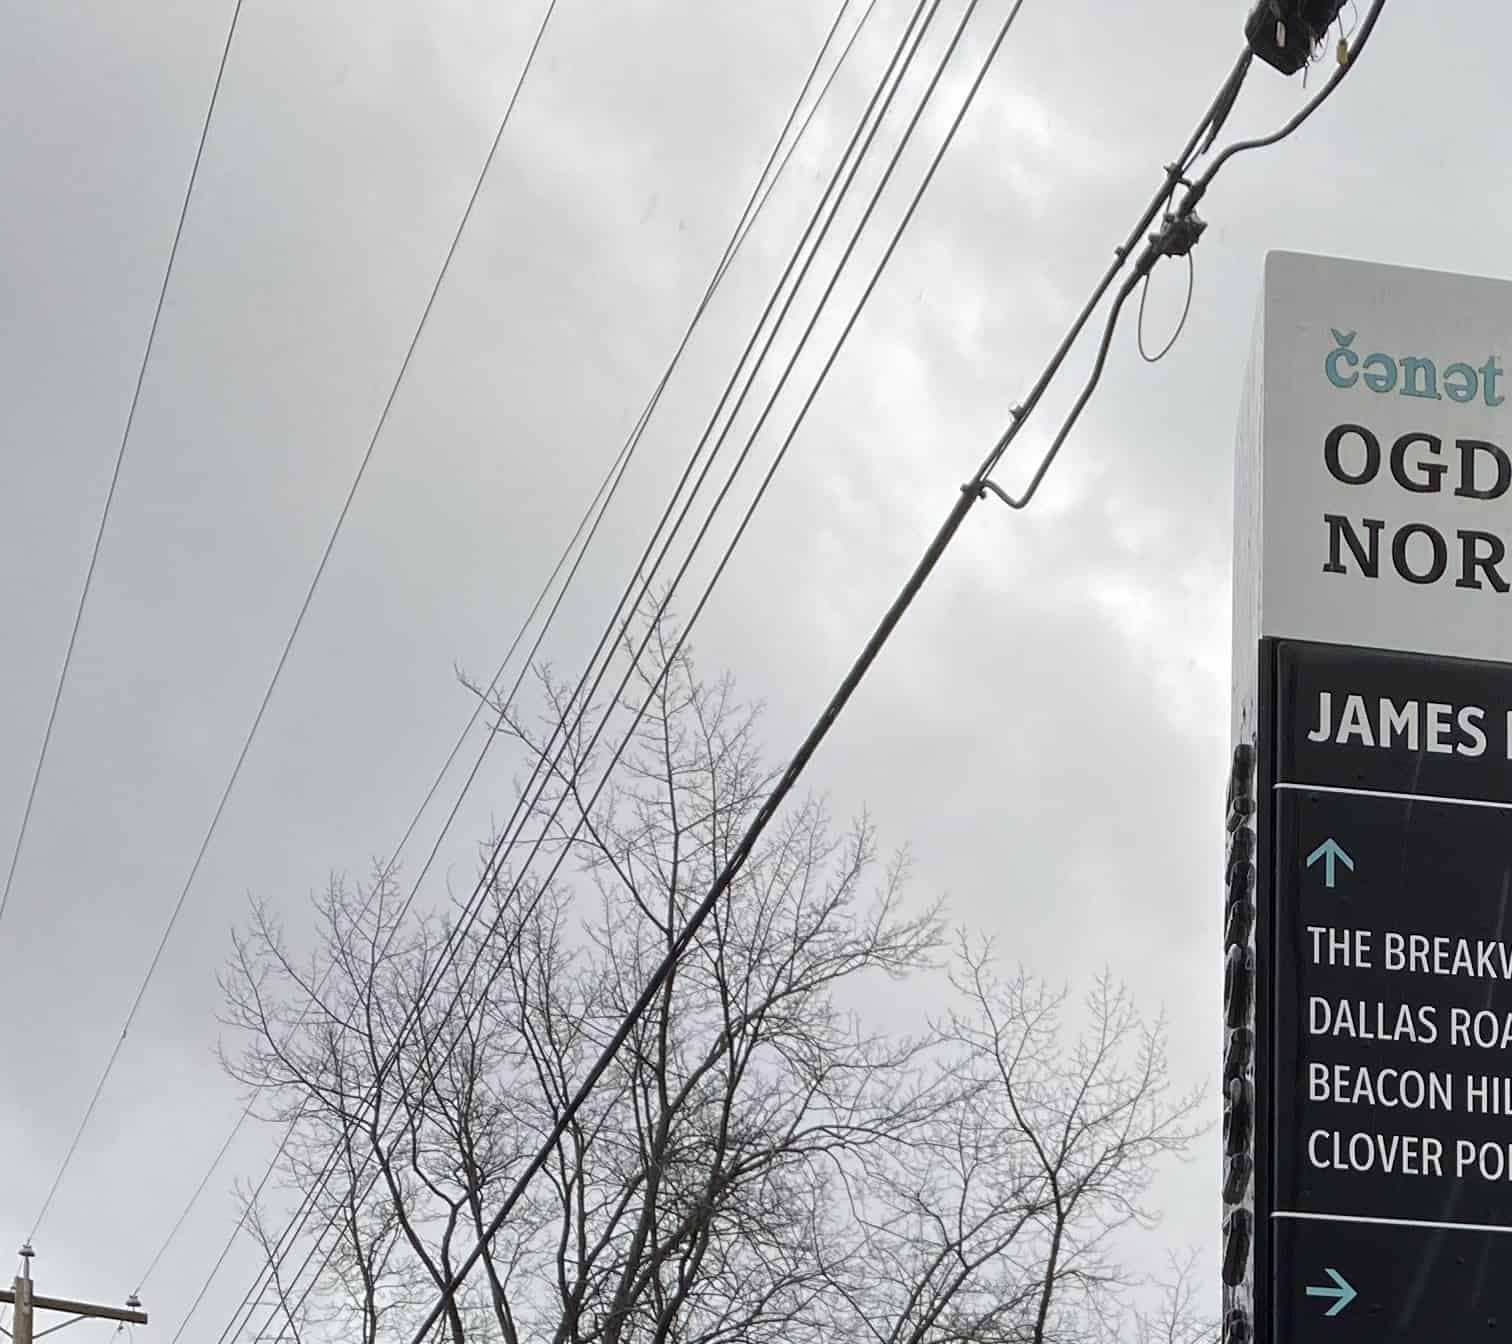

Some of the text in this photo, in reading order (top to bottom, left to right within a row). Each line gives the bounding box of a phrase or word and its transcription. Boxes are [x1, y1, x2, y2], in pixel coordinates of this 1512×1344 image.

[1308, 692, 1488, 758] JAMES
[1308, 926, 1372, 970] THE
[1308, 998, 1438, 1044] DALLAS
[1308, 1065, 1453, 1110] BEACON
[1308, 1131, 1444, 1176] CLOVER
